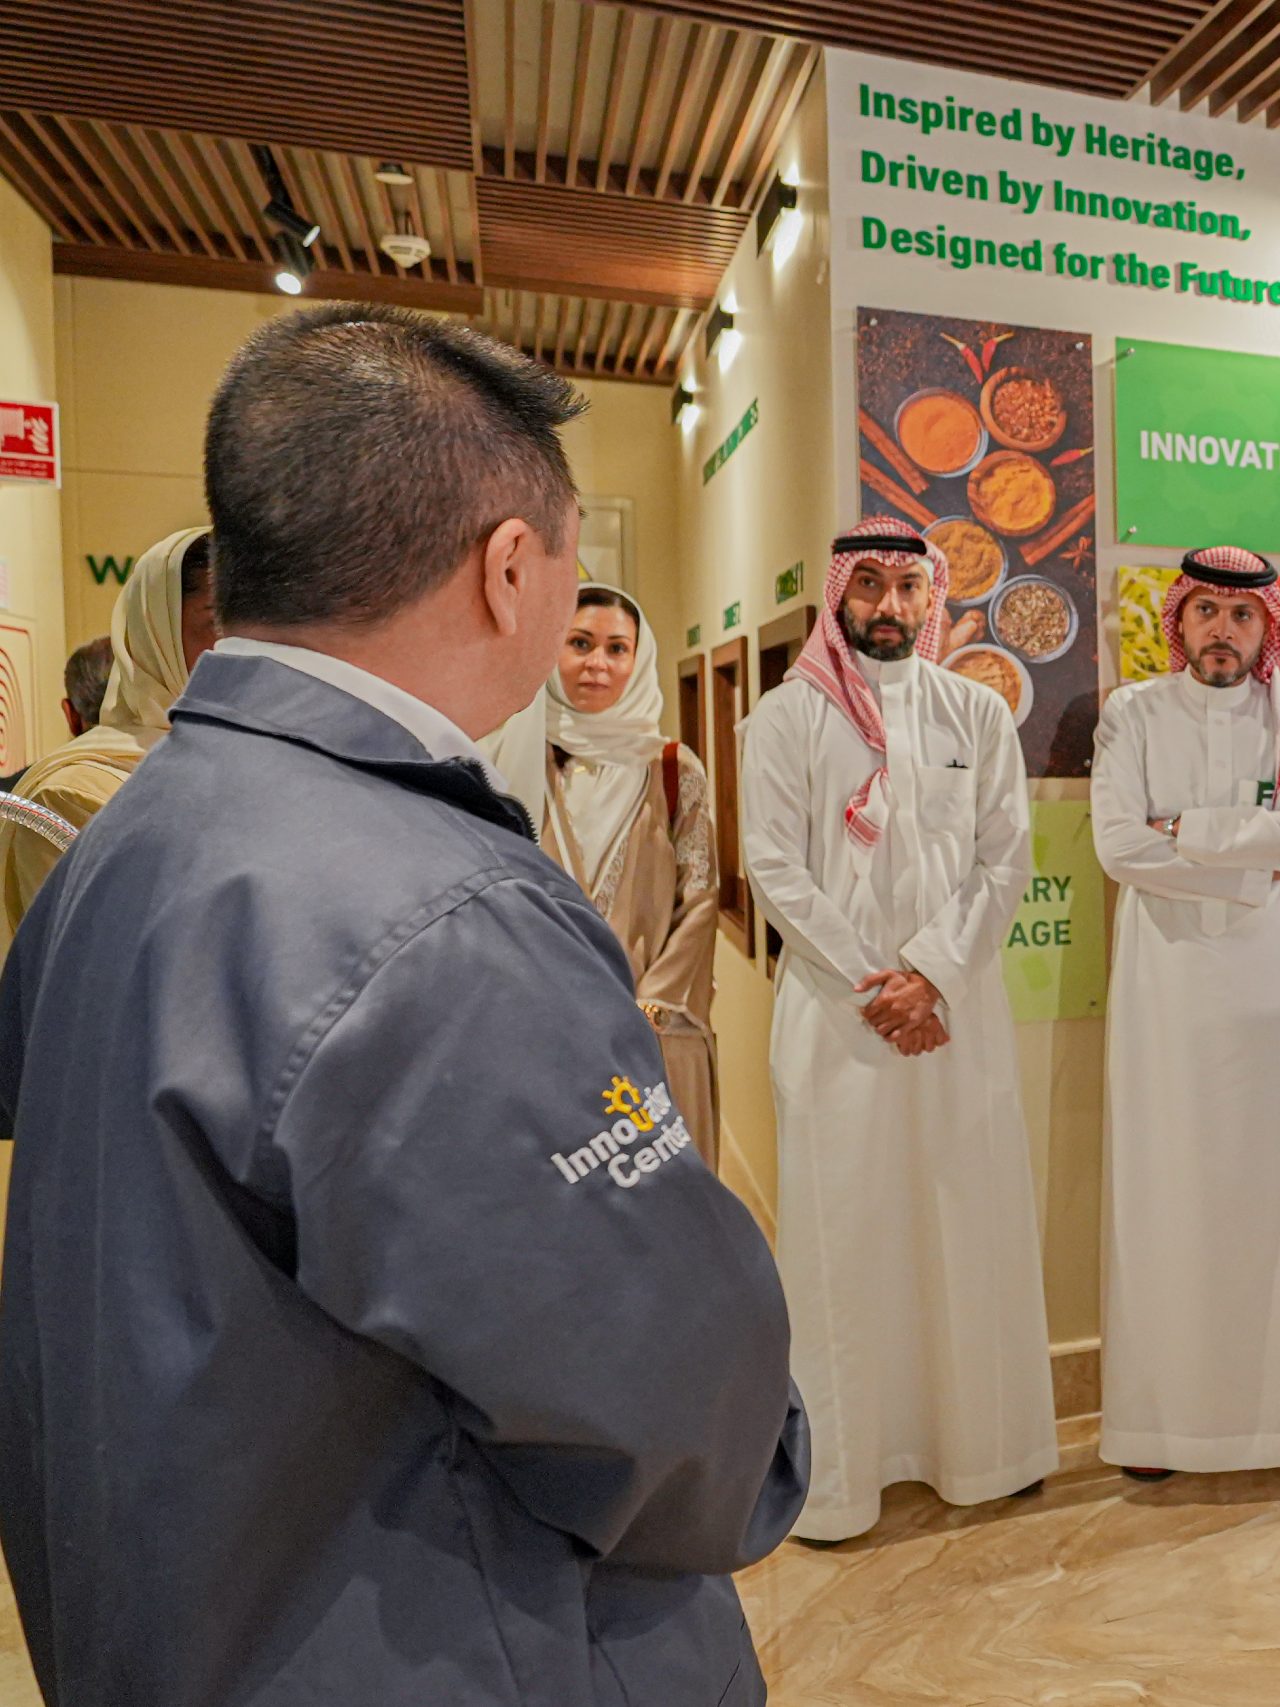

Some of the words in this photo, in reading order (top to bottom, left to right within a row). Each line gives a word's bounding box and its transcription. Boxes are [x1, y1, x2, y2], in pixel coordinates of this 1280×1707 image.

[859, 83, 1022, 142] Inspired
[1032, 113, 1075, 158] by
[1086, 123, 1246, 182] Heritage,
[861, 150, 988, 202] Driven
[1000, 171, 1043, 214] by
[1054, 180, 1251, 241] Innovation,
[862, 216, 1042, 270] Designed
[1053, 242, 1104, 280] for
[1114, 253, 1170, 289] the
[1023, 875, 1072, 903] RY
